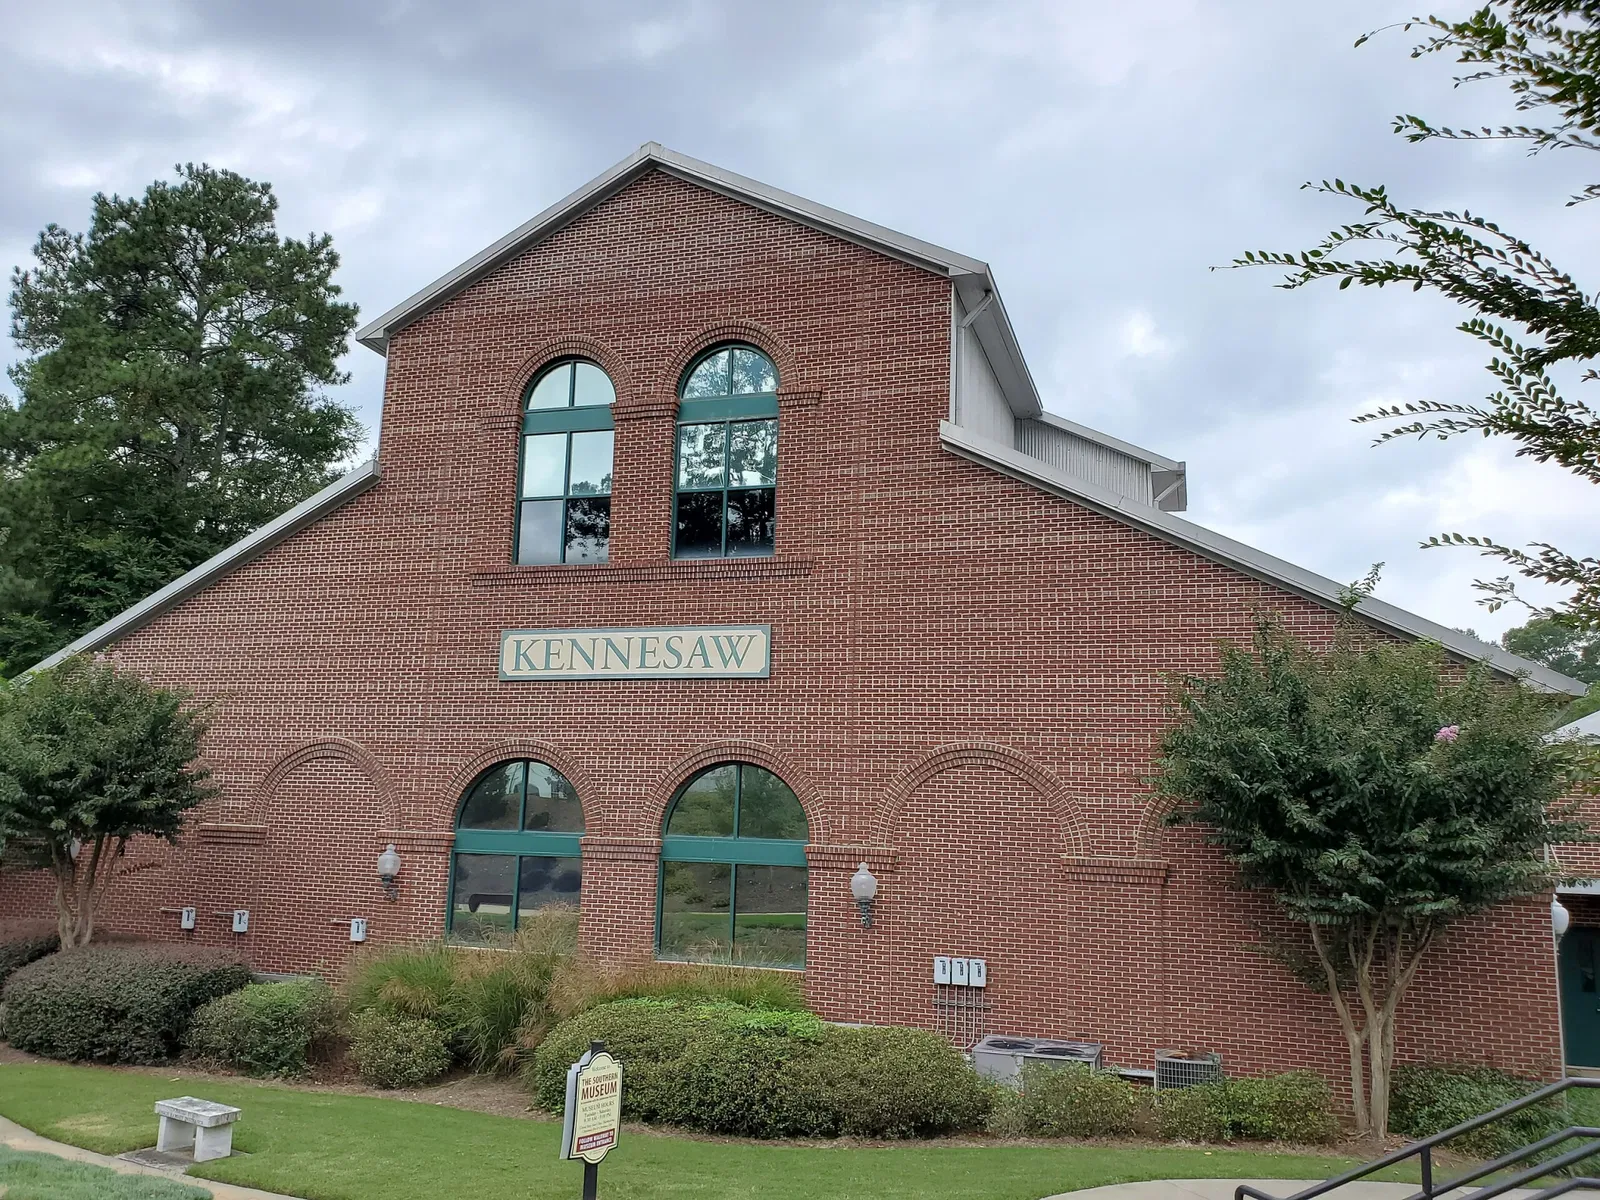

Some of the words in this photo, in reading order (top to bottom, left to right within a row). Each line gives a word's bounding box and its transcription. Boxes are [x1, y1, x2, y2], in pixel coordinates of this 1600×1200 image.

[511, 634, 757, 672] KENNESAW
[582, 1078, 592, 1086] THE
[593, 1072, 618, 1084] SOUTHERN
[581, 1081, 617, 1100] MUSEUM
